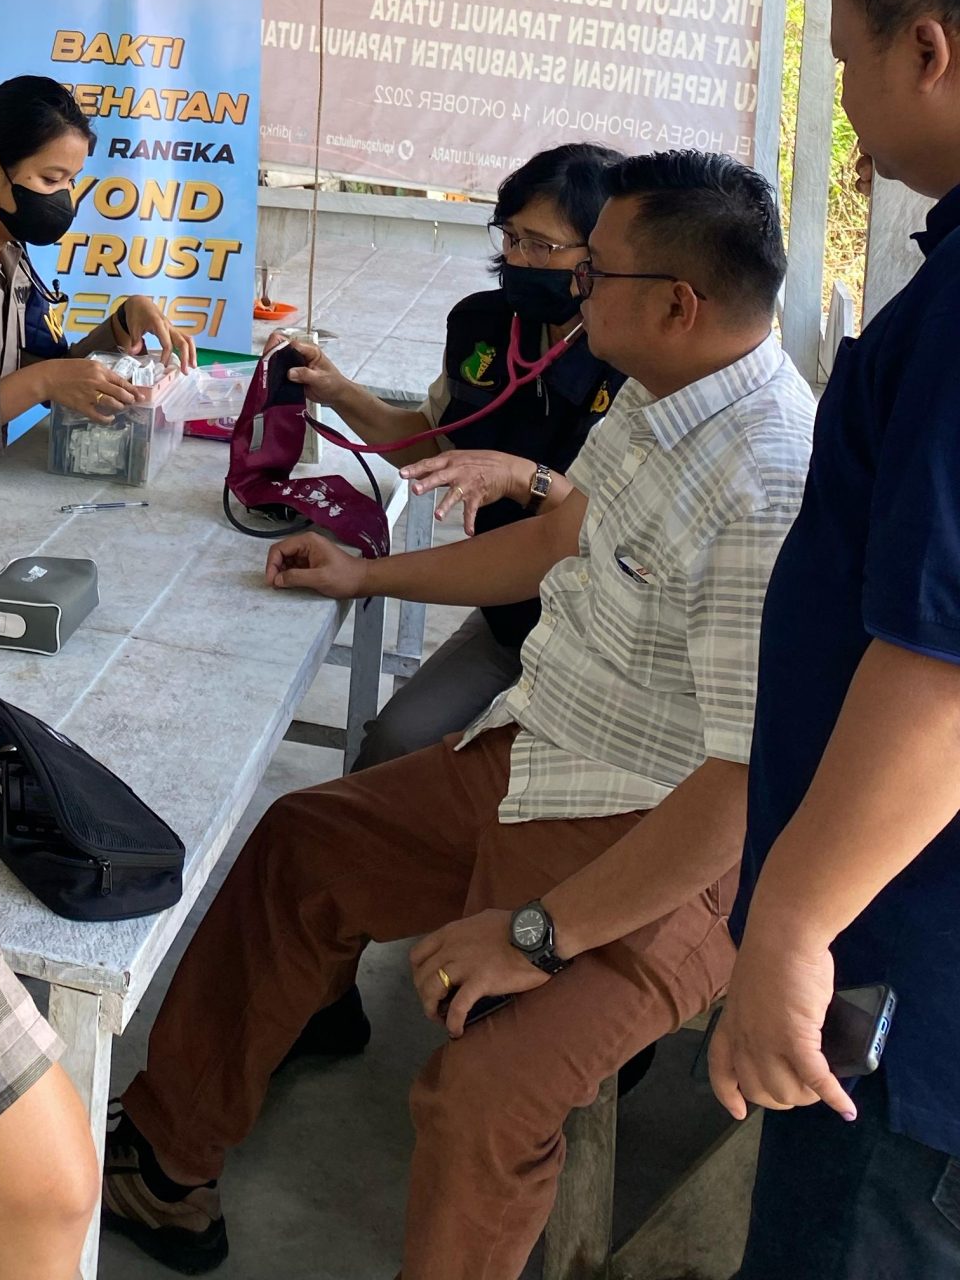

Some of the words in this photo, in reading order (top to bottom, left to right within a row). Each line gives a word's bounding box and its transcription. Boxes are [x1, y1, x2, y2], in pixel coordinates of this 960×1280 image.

[51, 30, 185, 69] BAKTI
[60, 83, 249, 125] EHATAN
[108, 138, 235, 164] RANGKA
[71, 175, 224, 222] YOND
[54, 233, 242, 281] TRUST
